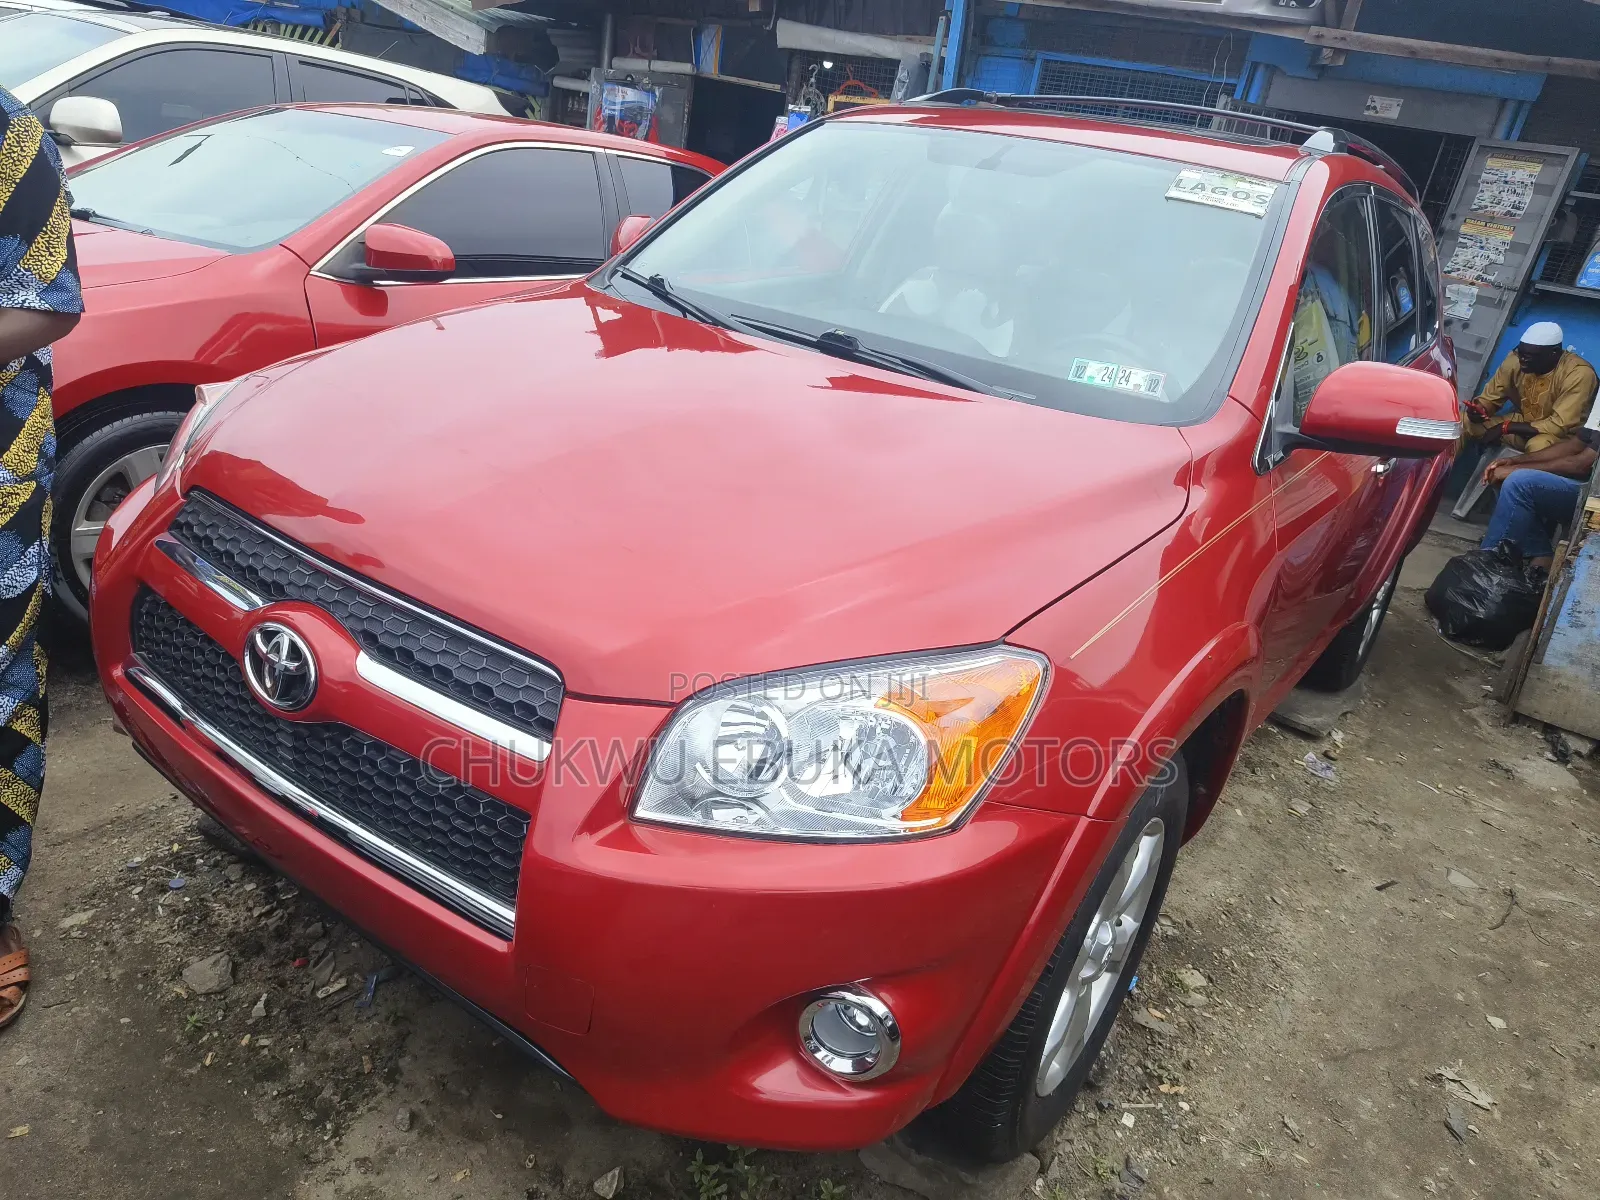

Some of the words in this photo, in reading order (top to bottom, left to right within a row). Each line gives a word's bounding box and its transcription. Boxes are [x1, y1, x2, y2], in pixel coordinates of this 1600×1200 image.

[1173, 178, 1269, 205] LAGOS
[1073, 364, 1087, 379] 12
[1100, 366, 1115, 383] 24
[1117, 369, 1132, 386] 24
[1147, 378, 1160, 393] 12
